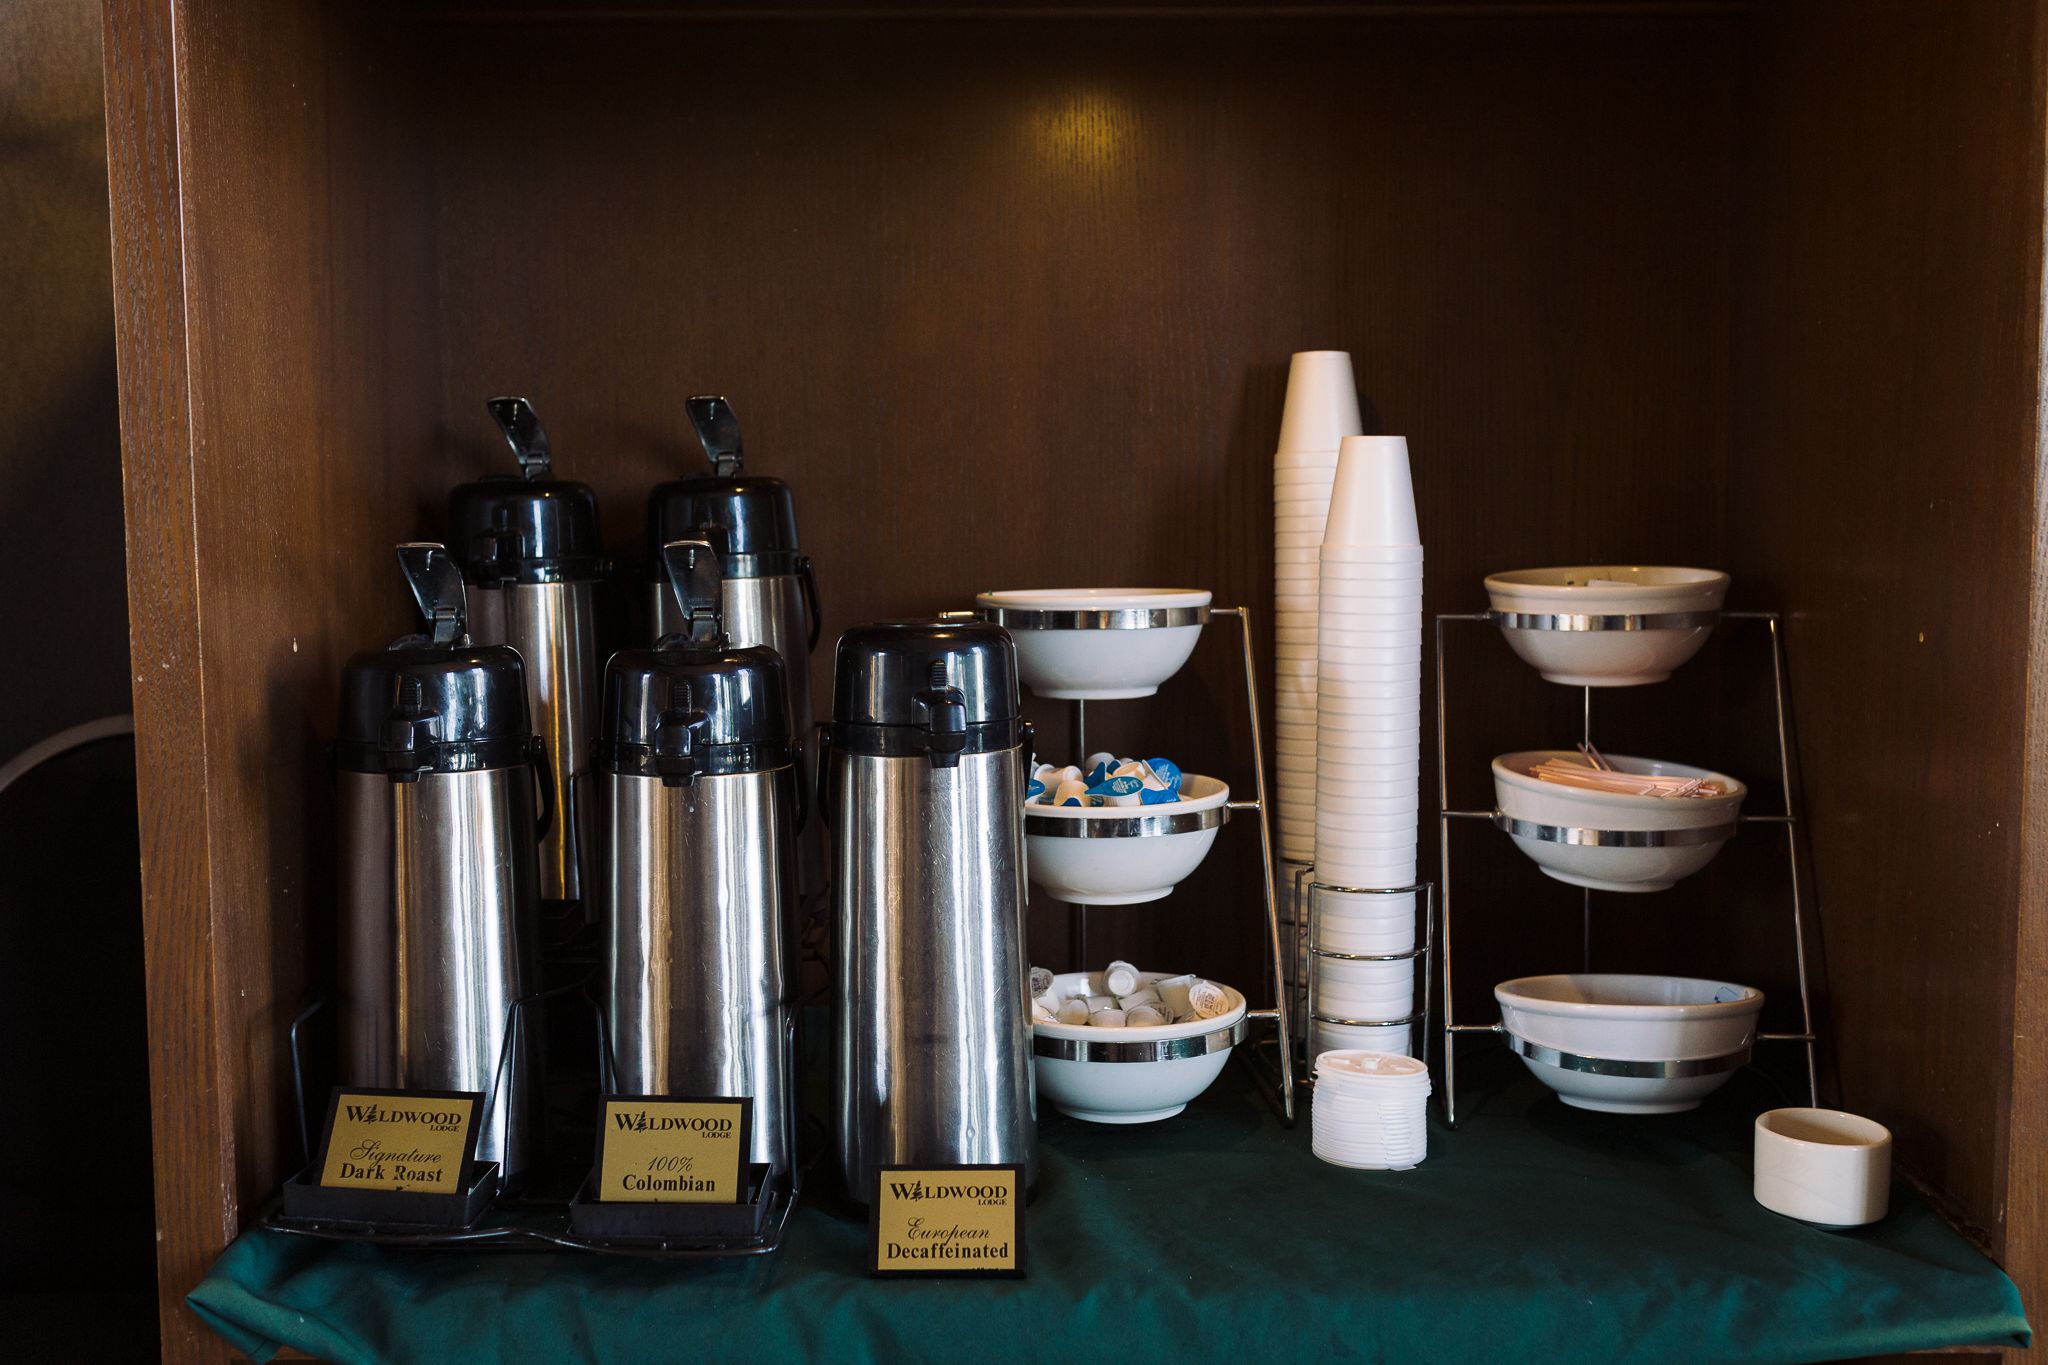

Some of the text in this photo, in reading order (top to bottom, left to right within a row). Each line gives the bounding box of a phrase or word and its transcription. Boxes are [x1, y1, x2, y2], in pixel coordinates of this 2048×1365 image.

[350, 1139, 442, 1169] Signature
[340, 1163, 444, 1183] Dark Roast
[648, 1156, 694, 1173] 100%
[622, 1174, 715, 1192] Colombian
[908, 1217, 990, 1245] European
[887, 1242, 1009, 1259] Decaffeinated
